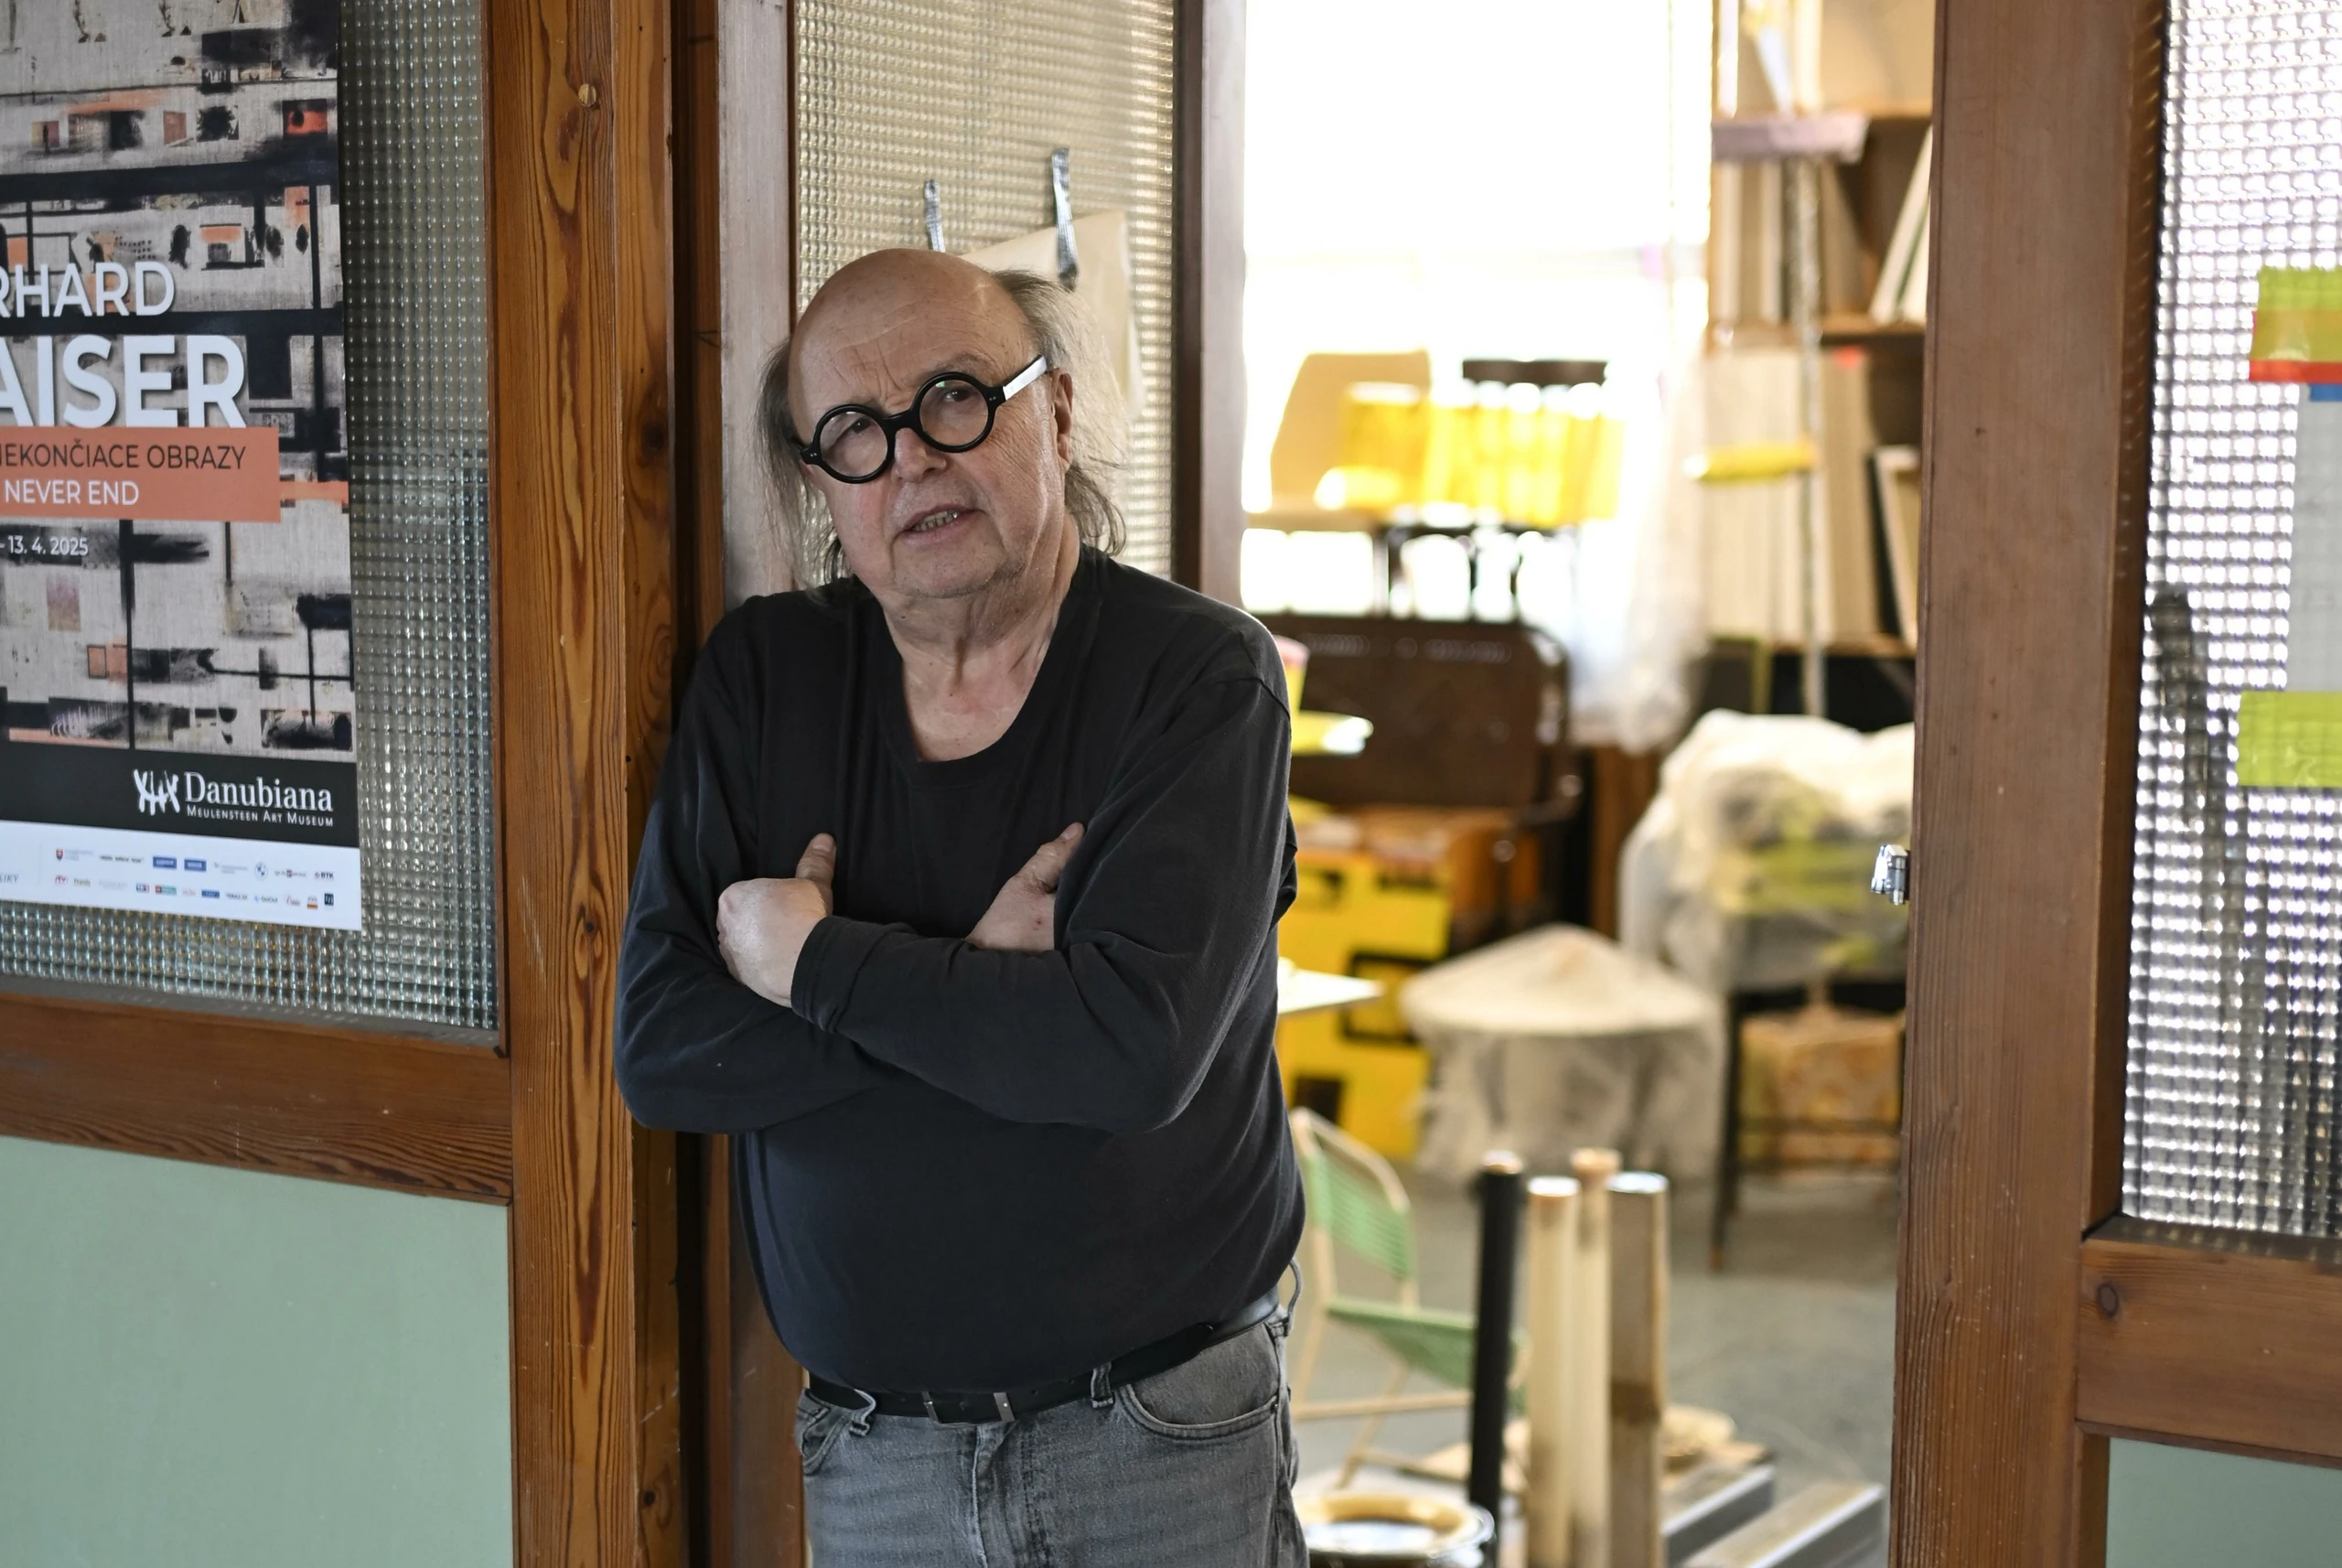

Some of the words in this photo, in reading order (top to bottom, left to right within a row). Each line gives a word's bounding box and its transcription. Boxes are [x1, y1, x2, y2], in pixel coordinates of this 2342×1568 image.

[0, 439, 139, 468] EKONČIACE
[147, 445, 246, 469] OBRAZY
[5, 479, 81, 504] NEVER
[88, 480, 139, 505] END
[7, 535, 27, 553] 13.
[32, 536, 46, 554] 4.
[49, 536, 89, 556] 2025
[184, 771, 334, 812] Danubiana
